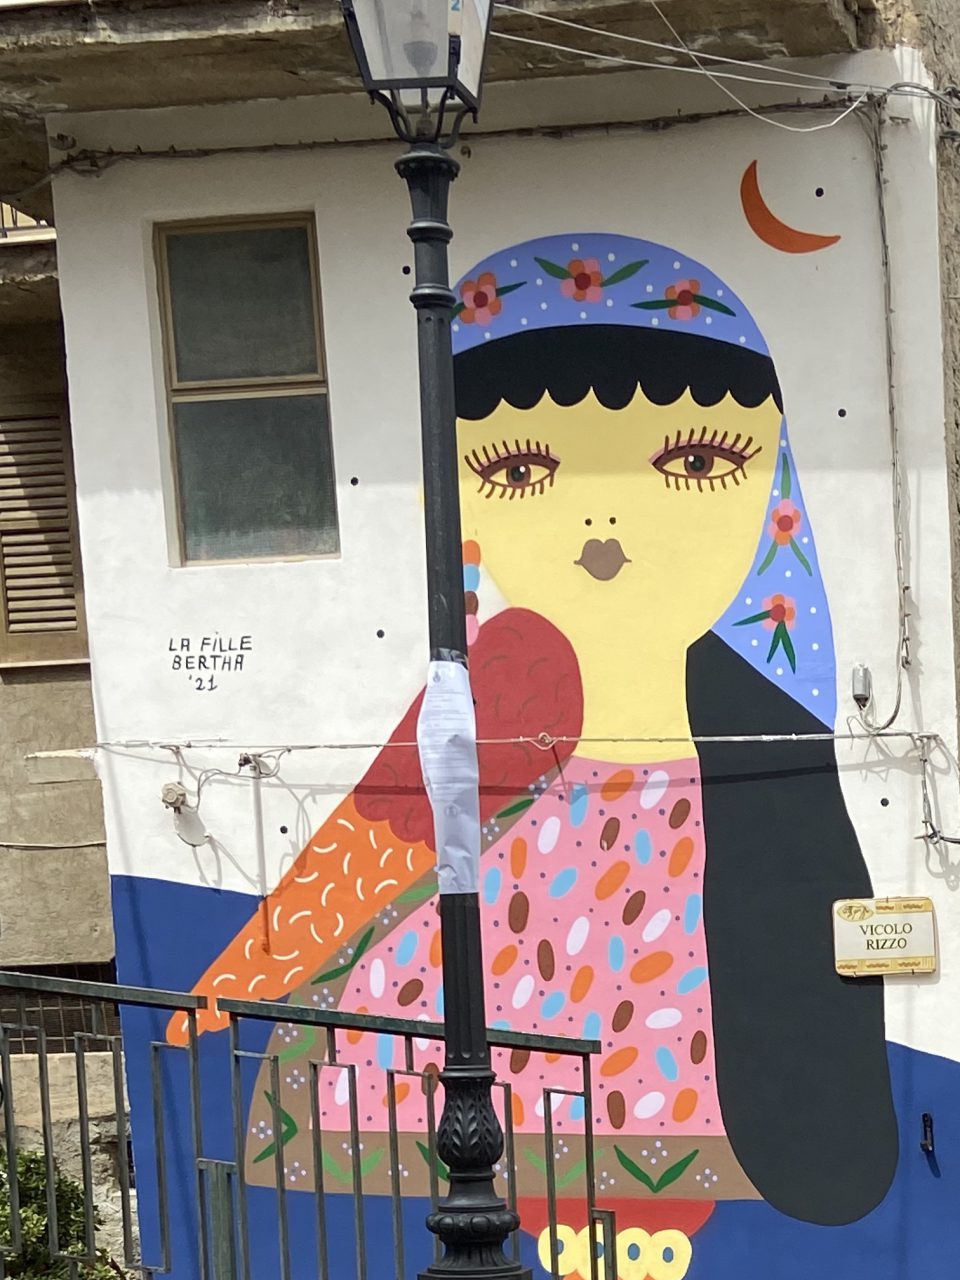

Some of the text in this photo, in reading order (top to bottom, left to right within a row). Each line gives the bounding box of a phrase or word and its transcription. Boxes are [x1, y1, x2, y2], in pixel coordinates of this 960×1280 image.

[168, 637, 190, 652] LA
[172, 654, 245, 672] BERTHA
[188, 674, 218, 692] '21
[859, 922, 913, 936] VICOLO
[866, 937, 907, 950] RIZZO
